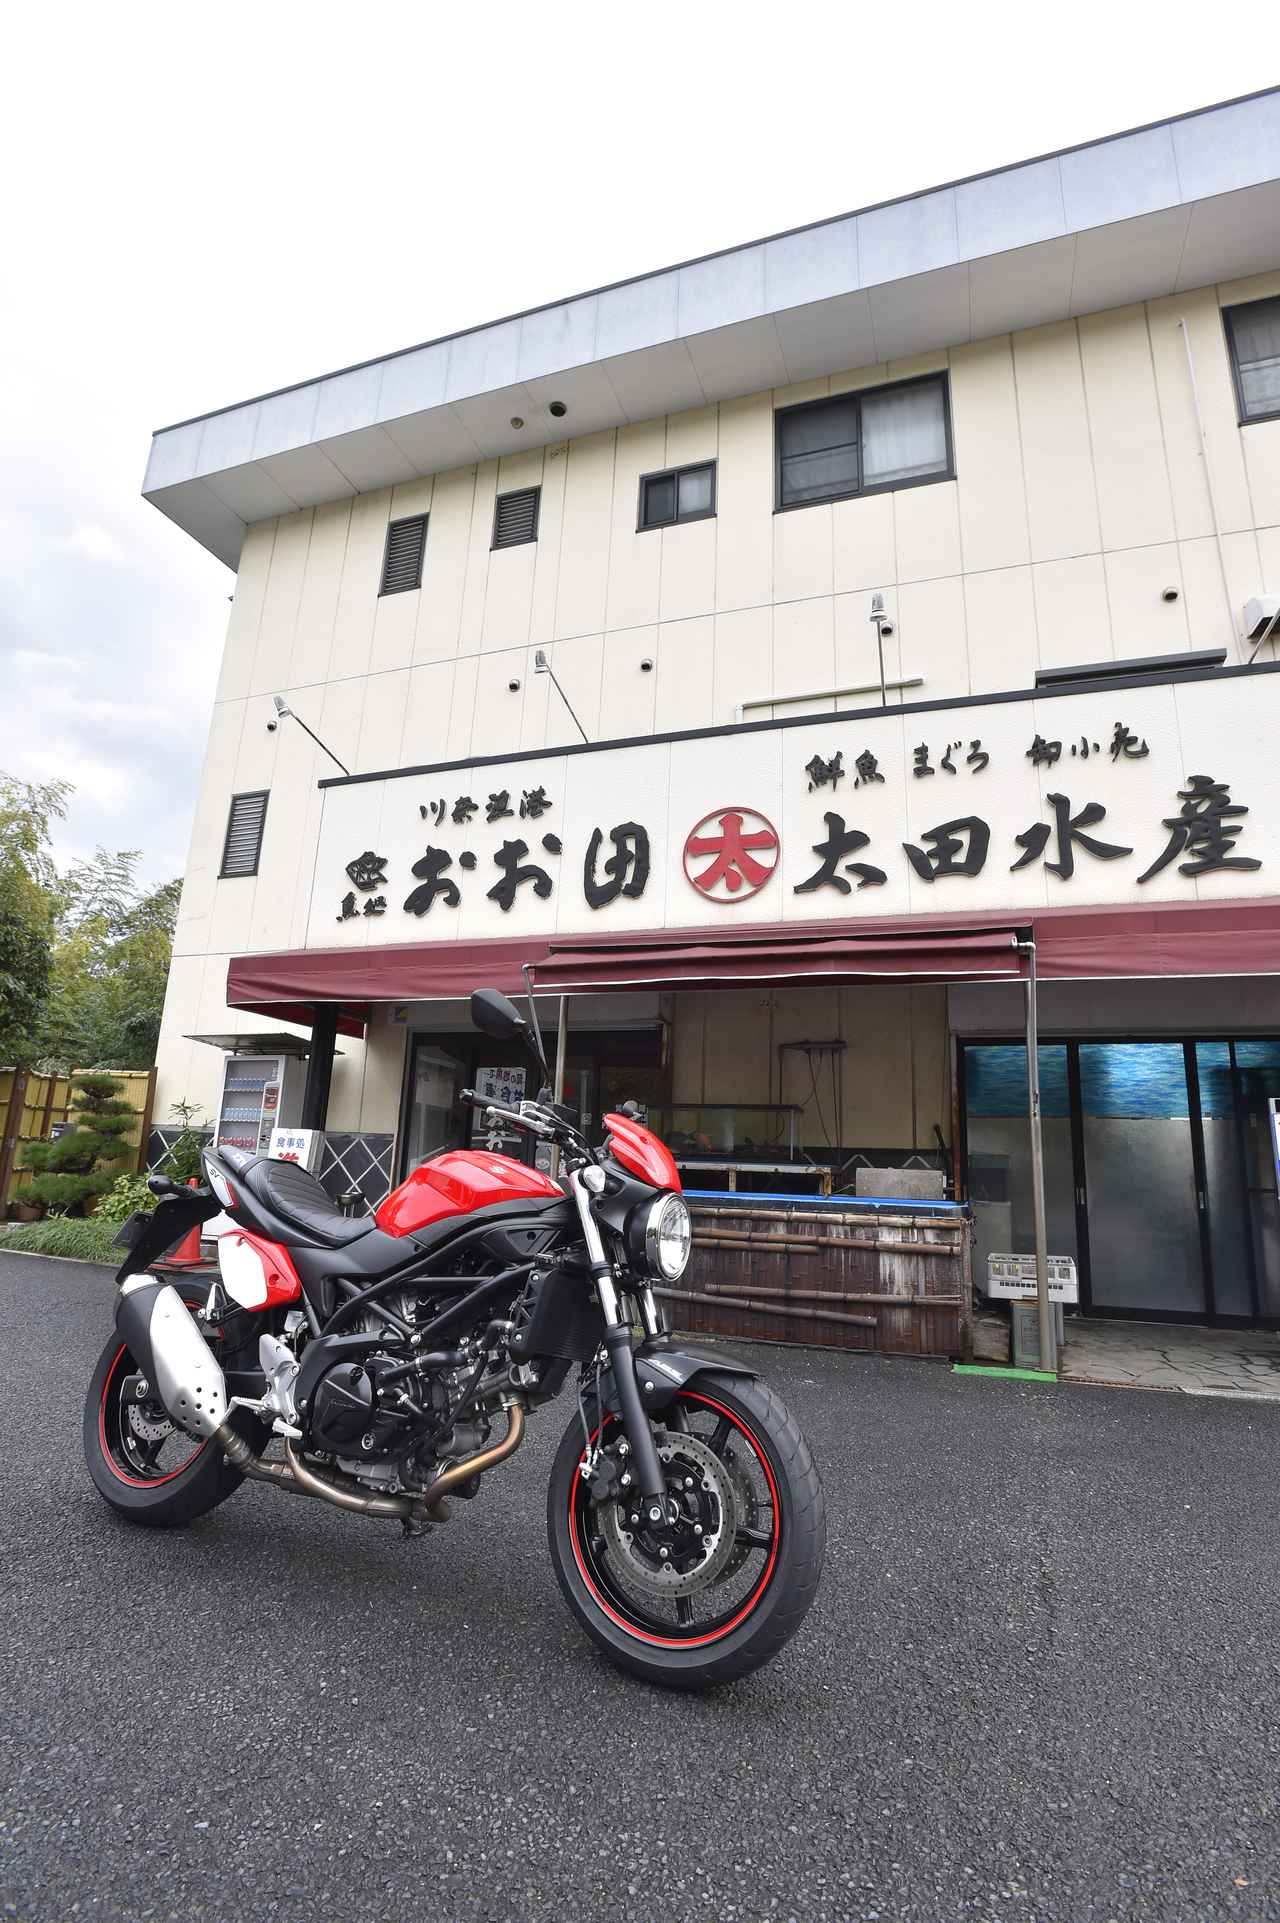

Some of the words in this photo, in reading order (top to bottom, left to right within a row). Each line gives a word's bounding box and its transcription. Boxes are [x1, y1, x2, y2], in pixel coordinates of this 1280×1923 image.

[805, 750, 885, 792] 鮮魚
[914, 740, 989, 778] まぐろ
[1026, 722, 1149, 768] 卸小売
[686, 811, 779, 893] 太
[794, 774, 1262, 894] 太田水産
[276, 1136, 304, 1148] 食事処
